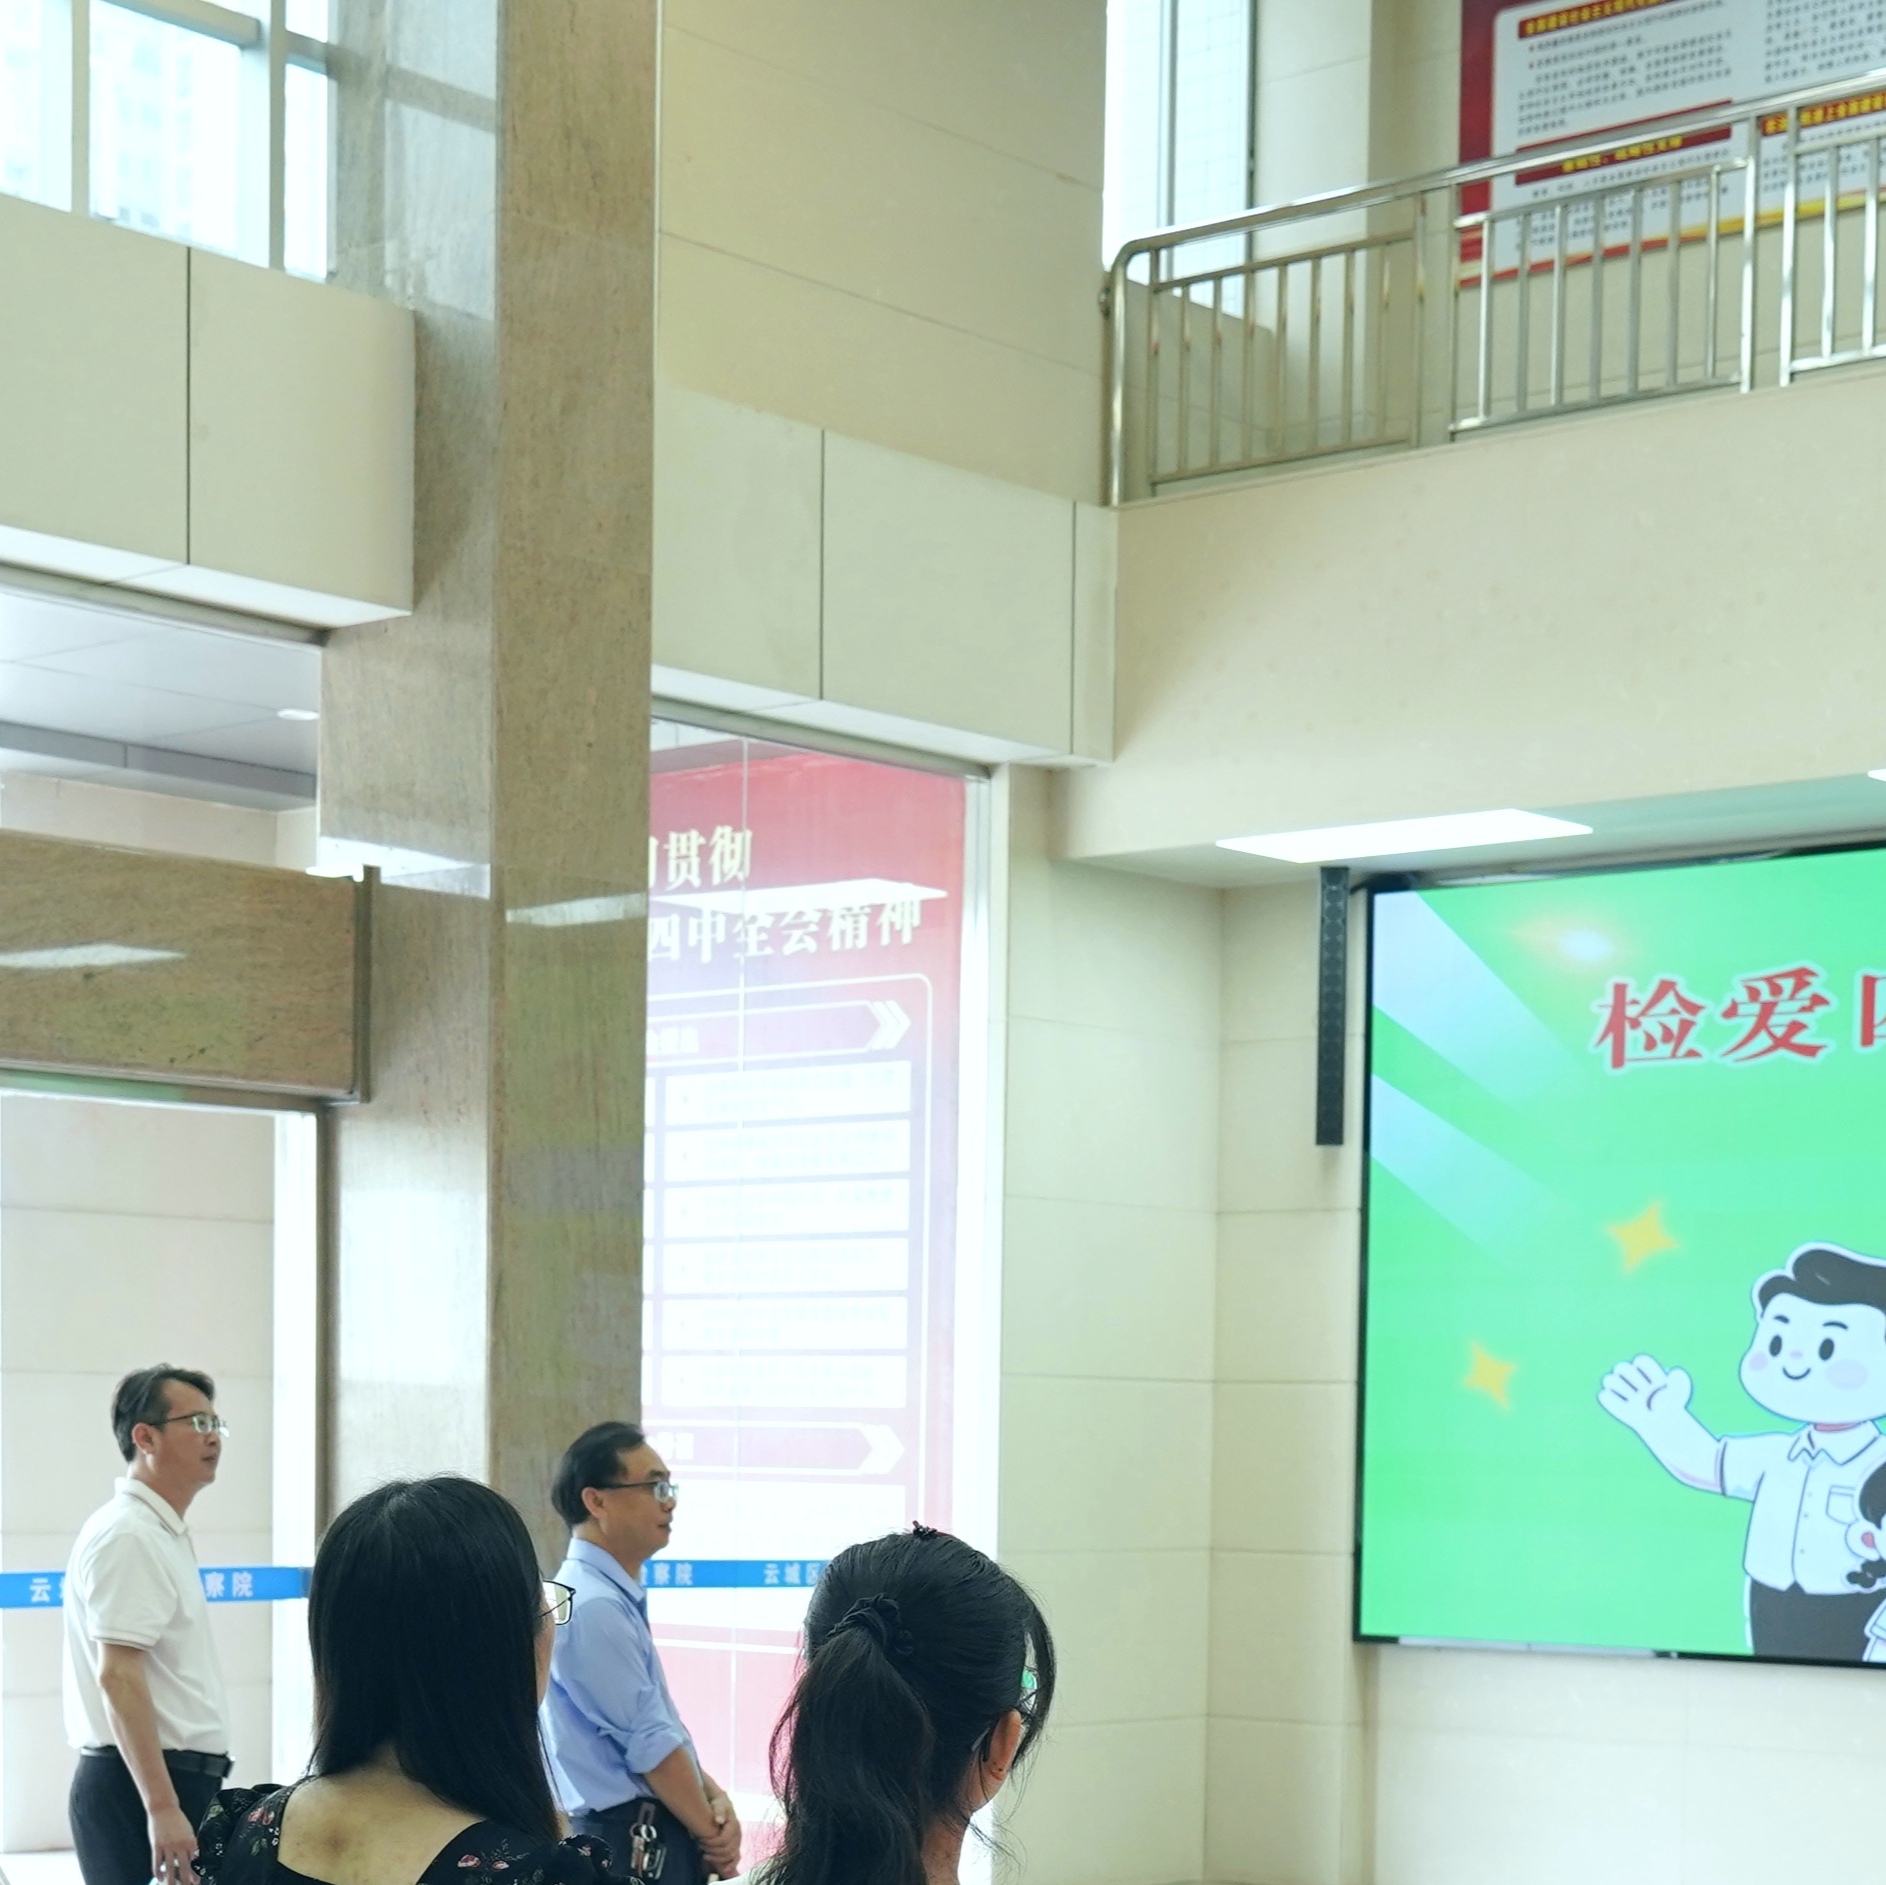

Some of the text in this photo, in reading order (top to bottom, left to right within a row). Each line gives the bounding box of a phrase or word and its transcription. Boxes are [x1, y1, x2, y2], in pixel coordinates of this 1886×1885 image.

[649, 825, 752, 892] 贯彻
[647, 899, 921, 963] 四中全会精神
